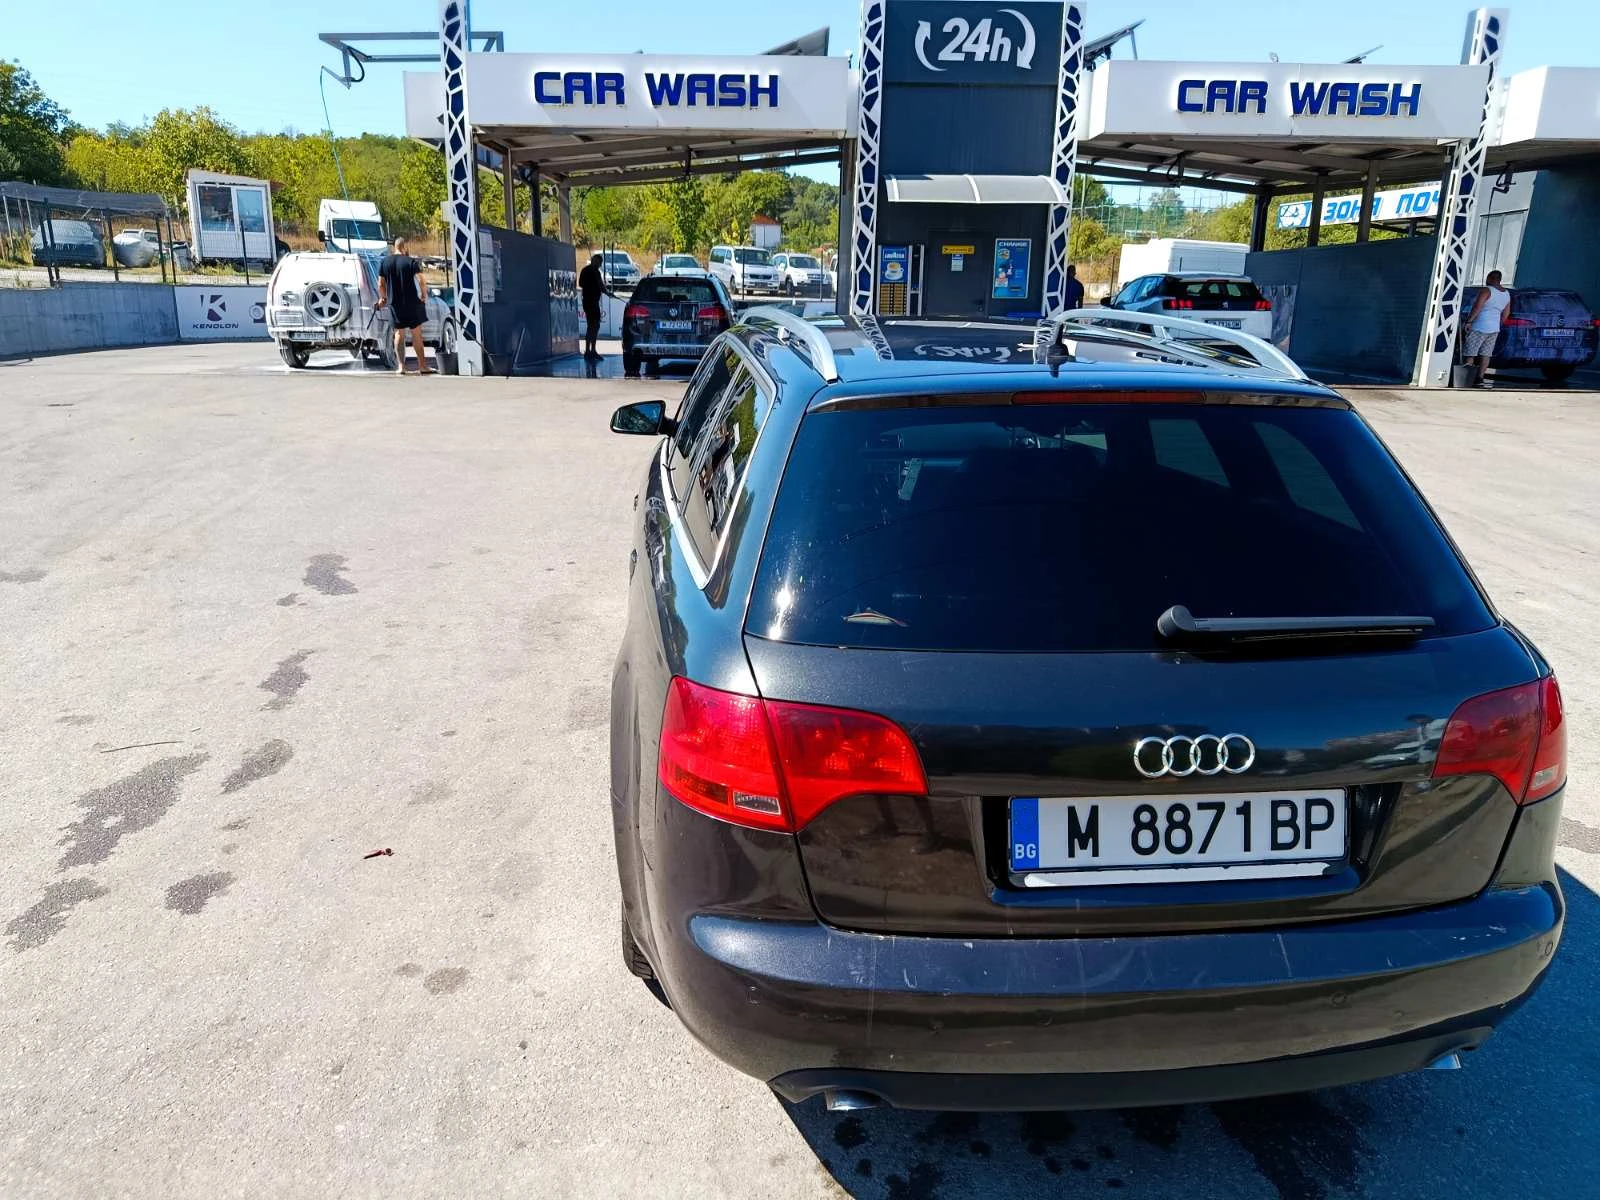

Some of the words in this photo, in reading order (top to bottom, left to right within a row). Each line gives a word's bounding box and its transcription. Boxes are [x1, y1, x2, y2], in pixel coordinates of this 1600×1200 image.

[937, 17, 1012, 62] 24h
[534, 71, 625, 105] CAR
[645, 73, 779, 107] WASH
[1177, 79, 1269, 114] CAR
[1290, 81, 1422, 117] WASH
[1066, 804, 1100, 858] M
[1014, 843, 1037, 860] BG
